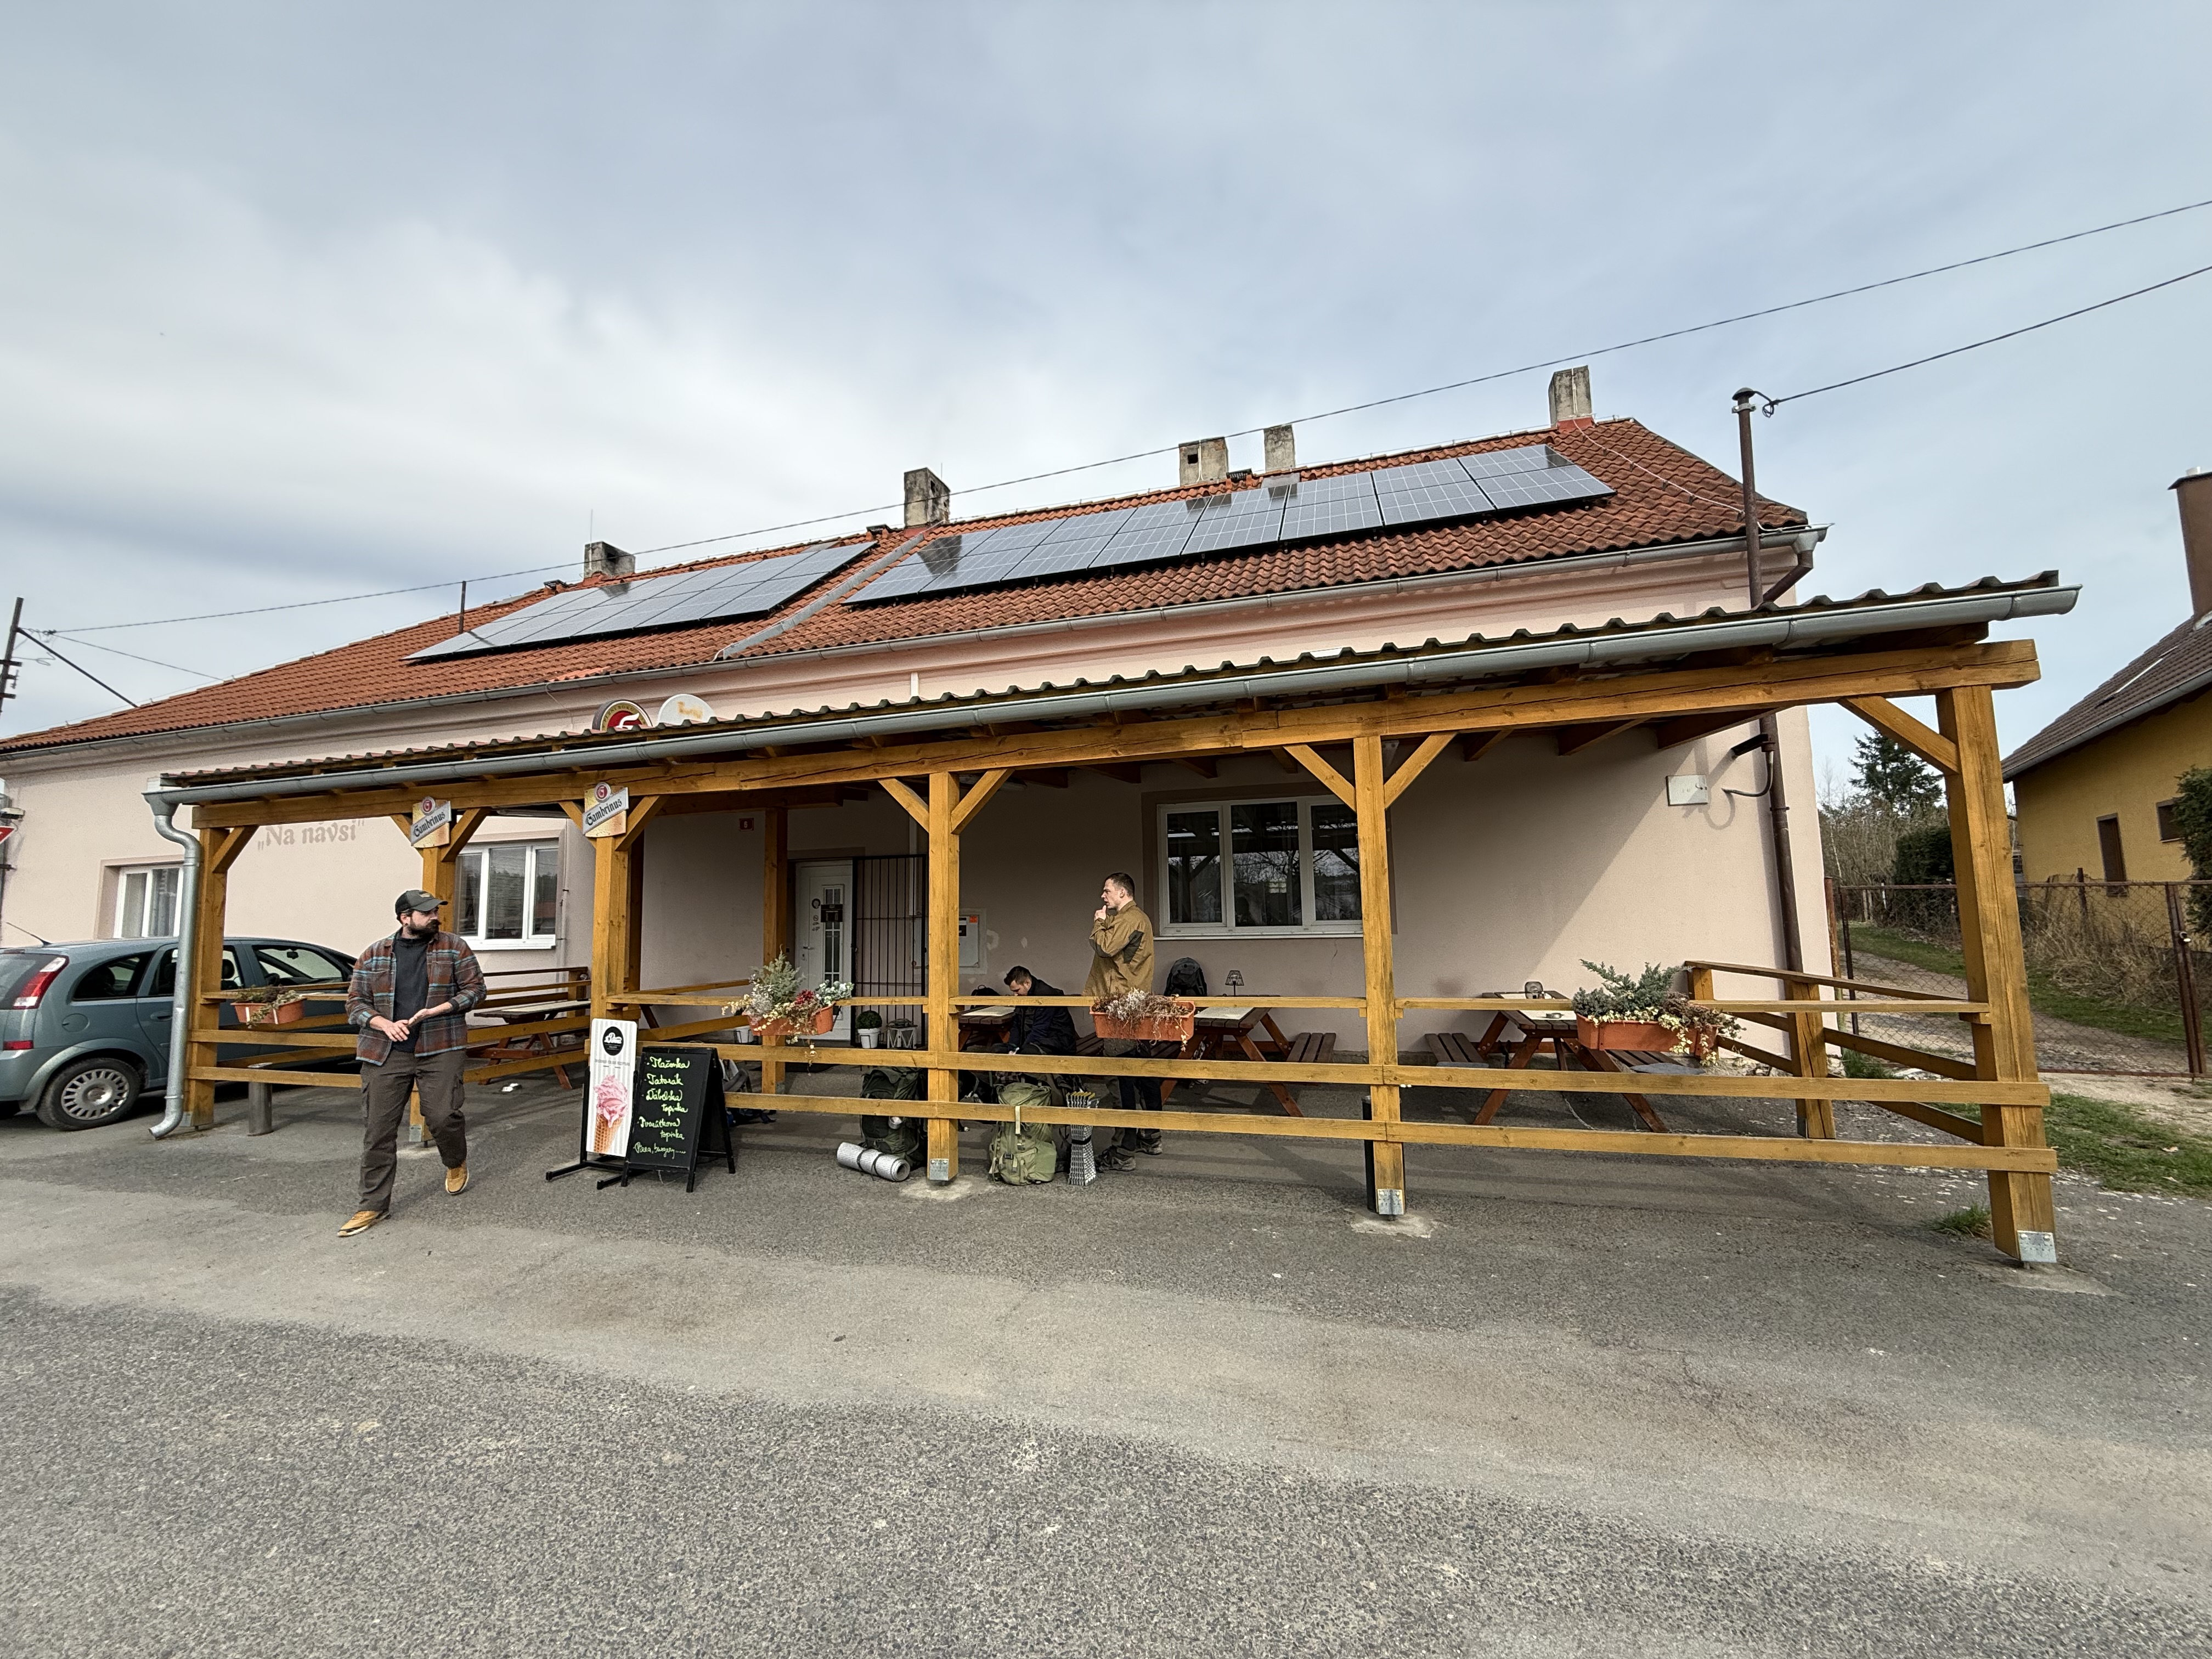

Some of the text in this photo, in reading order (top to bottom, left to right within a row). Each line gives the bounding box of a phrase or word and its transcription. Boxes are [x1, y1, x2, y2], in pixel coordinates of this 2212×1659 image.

[413, 812, 445, 837] Gambrinus
[585, 799, 622, 826] Gambrinus
[660, 1128, 685, 1142] topinka
